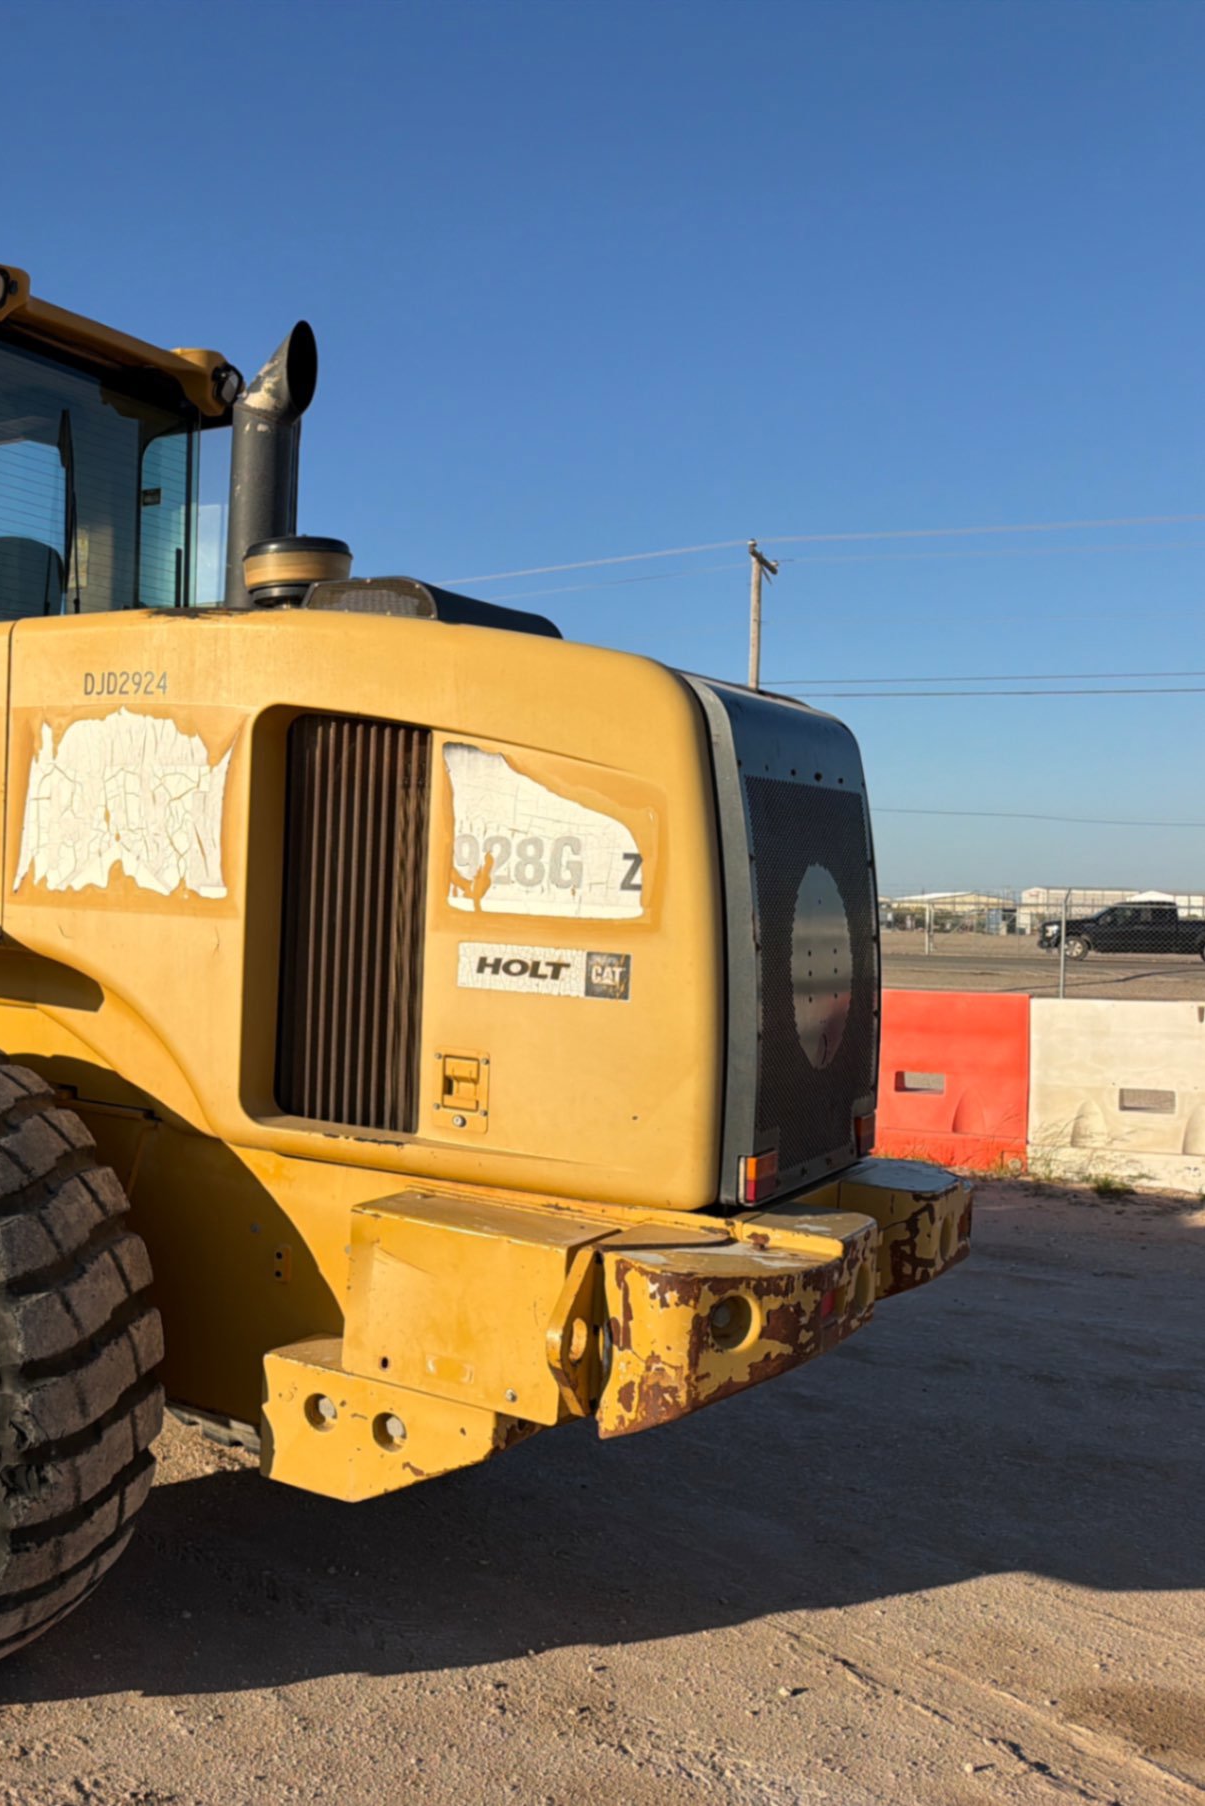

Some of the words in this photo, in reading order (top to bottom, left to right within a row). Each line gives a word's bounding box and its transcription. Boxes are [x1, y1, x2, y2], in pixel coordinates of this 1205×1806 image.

[84, 671, 168, 696] DJD2924
[476, 956, 571, 980] HOLT
[591, 965, 626, 986] CAT
